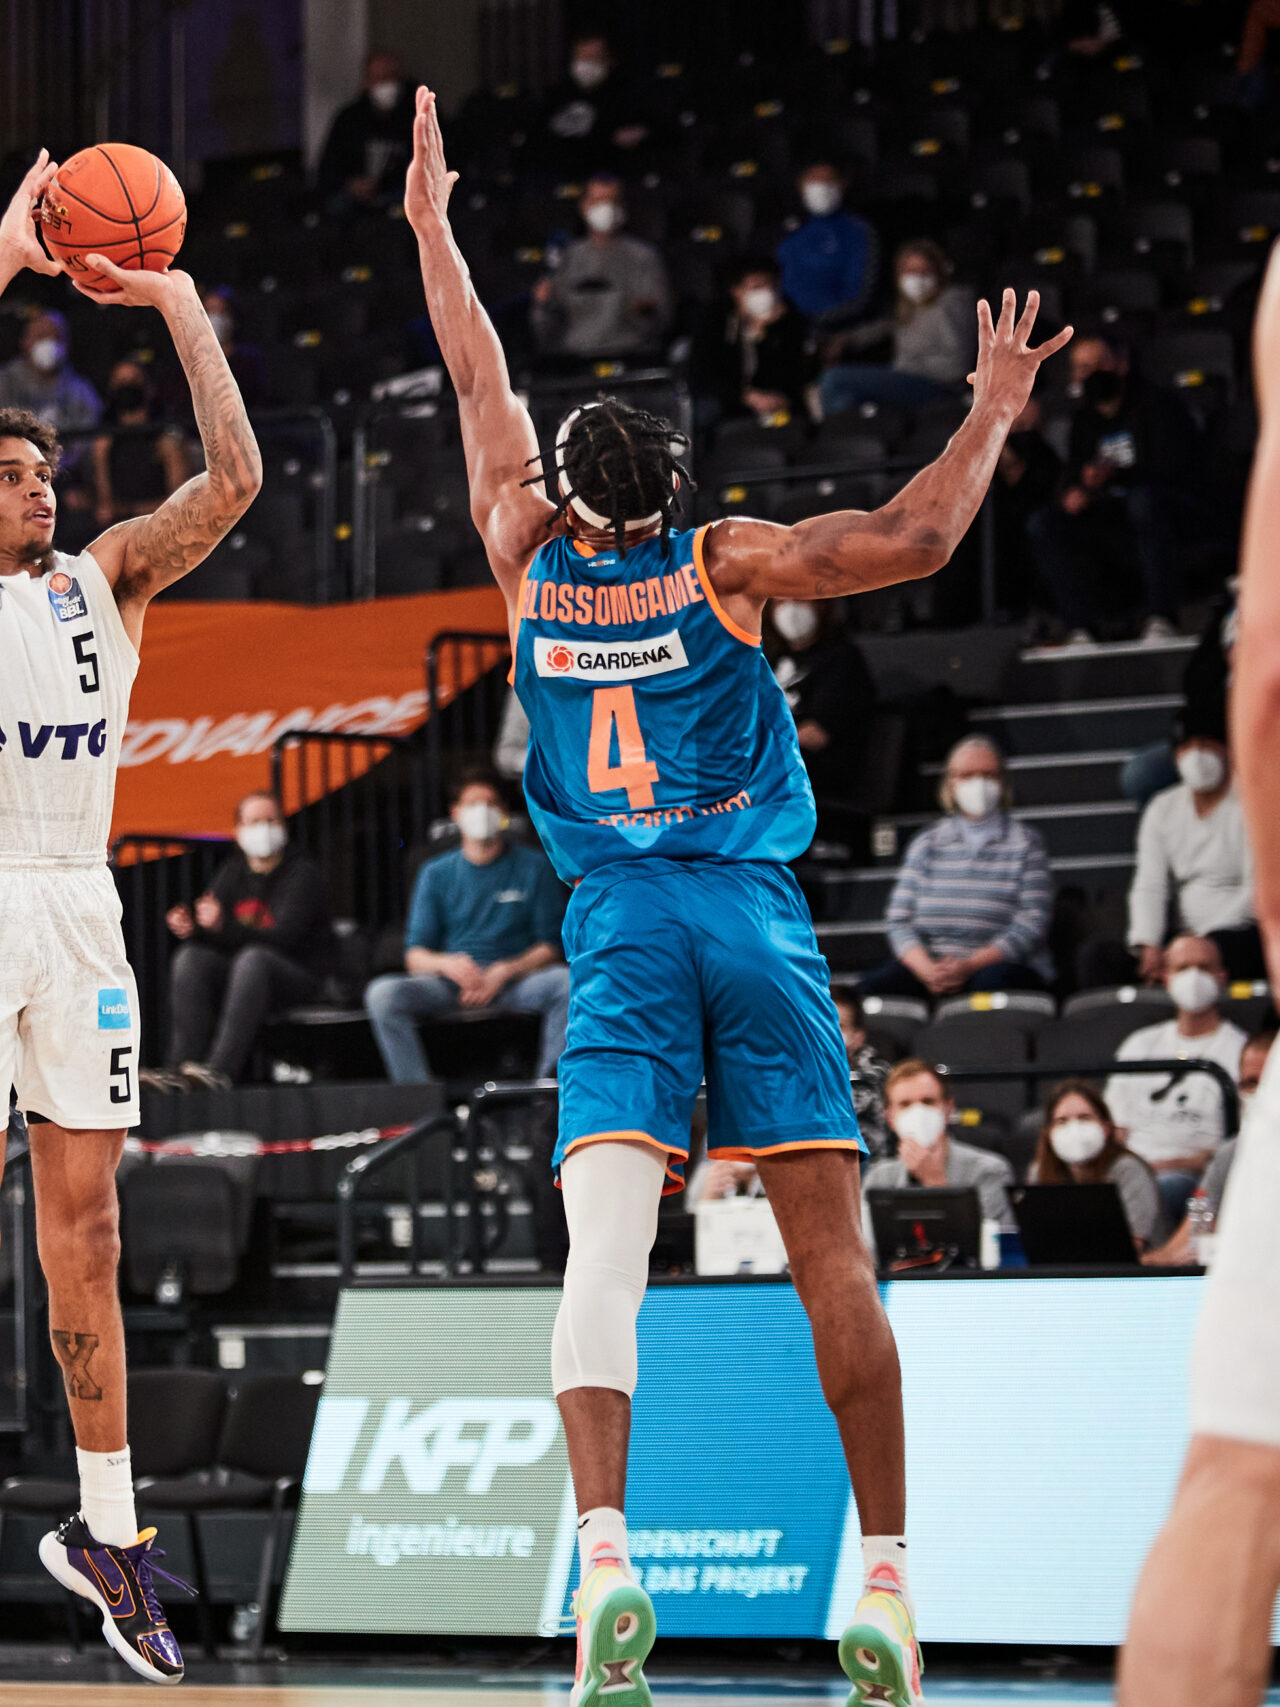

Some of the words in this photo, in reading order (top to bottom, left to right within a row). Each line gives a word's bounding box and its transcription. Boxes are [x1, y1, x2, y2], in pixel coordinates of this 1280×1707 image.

[59, 602, 84, 619] BBL
[72, 630, 100, 694] 5
[577, 645, 673, 670] GARDENA
[18, 718, 107, 760] VTG
[587, 685, 660, 810] 4
[109, 1046, 132, 1103] 5
[345, 1516, 537, 1567] ingenieure
[646, 1565, 700, 1595] DAS
[700, 1565, 811, 1600] PROJEKT
